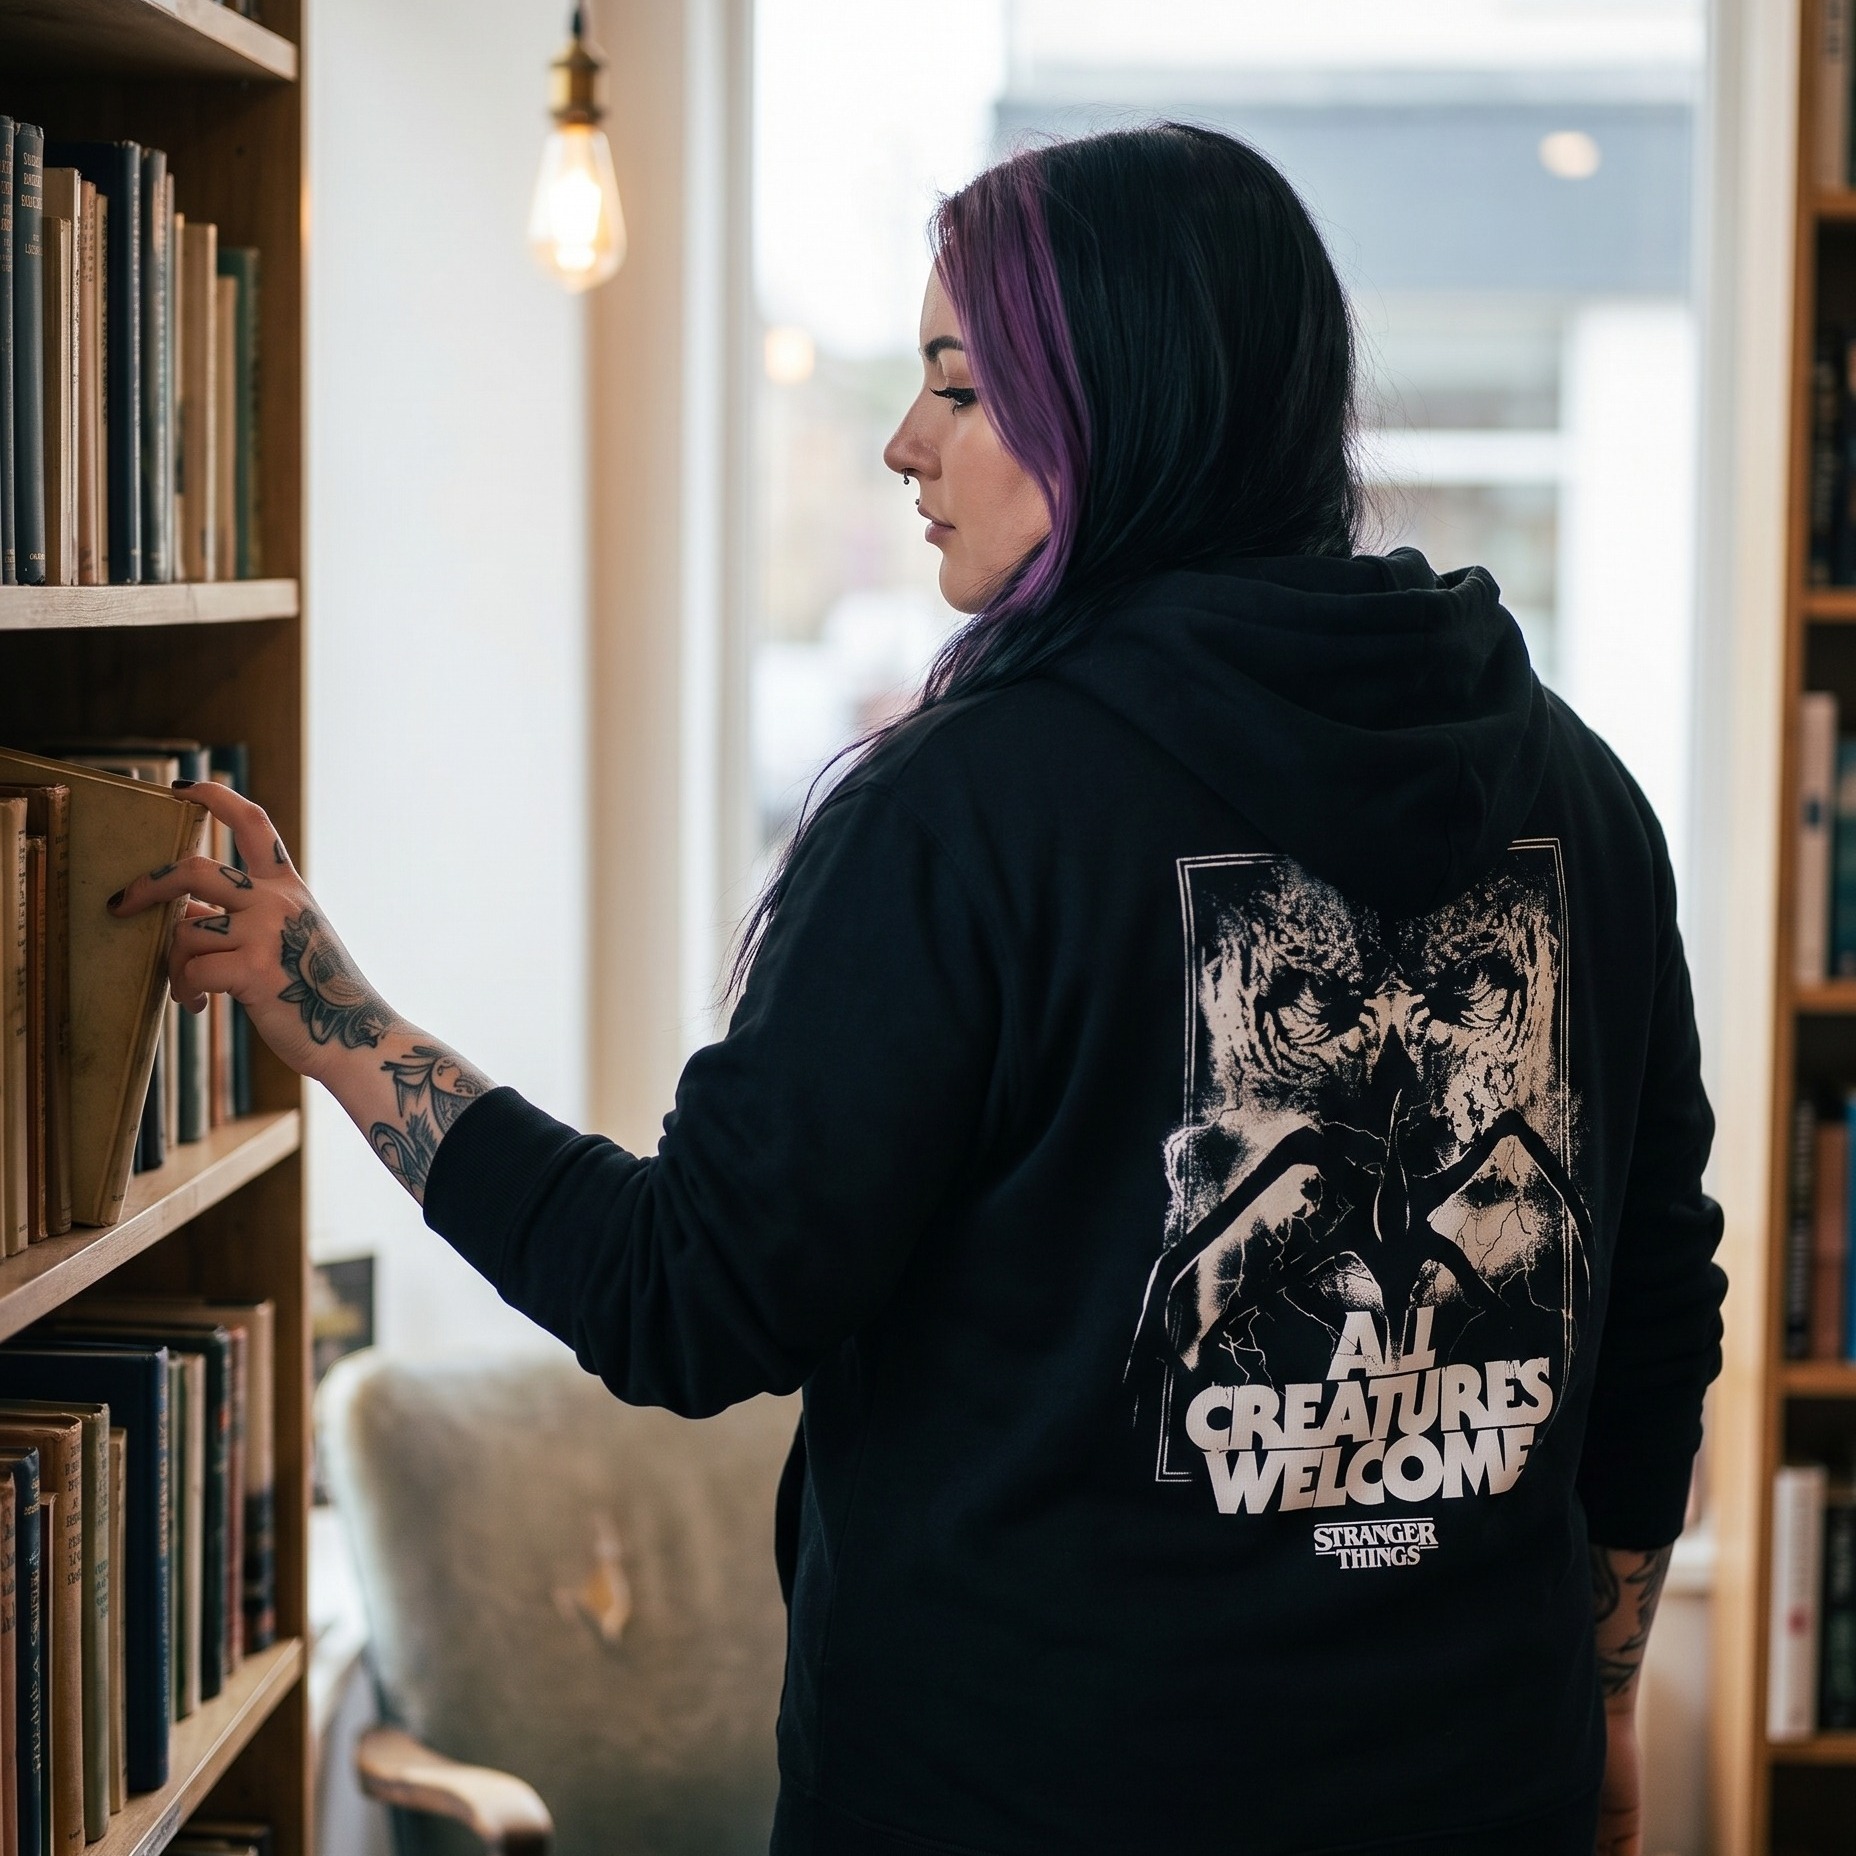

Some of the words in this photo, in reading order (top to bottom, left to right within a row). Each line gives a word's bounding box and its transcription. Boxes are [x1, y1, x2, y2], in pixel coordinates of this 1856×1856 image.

[1326, 1306, 1436, 1381] ALL
[1186, 1357, 1553, 1451] CREATURES
[1204, 1427, 1534, 1514] WELCOME
[1313, 1522, 1439, 1552] STRANGER
[1335, 1545, 1421, 1569] THINGS
